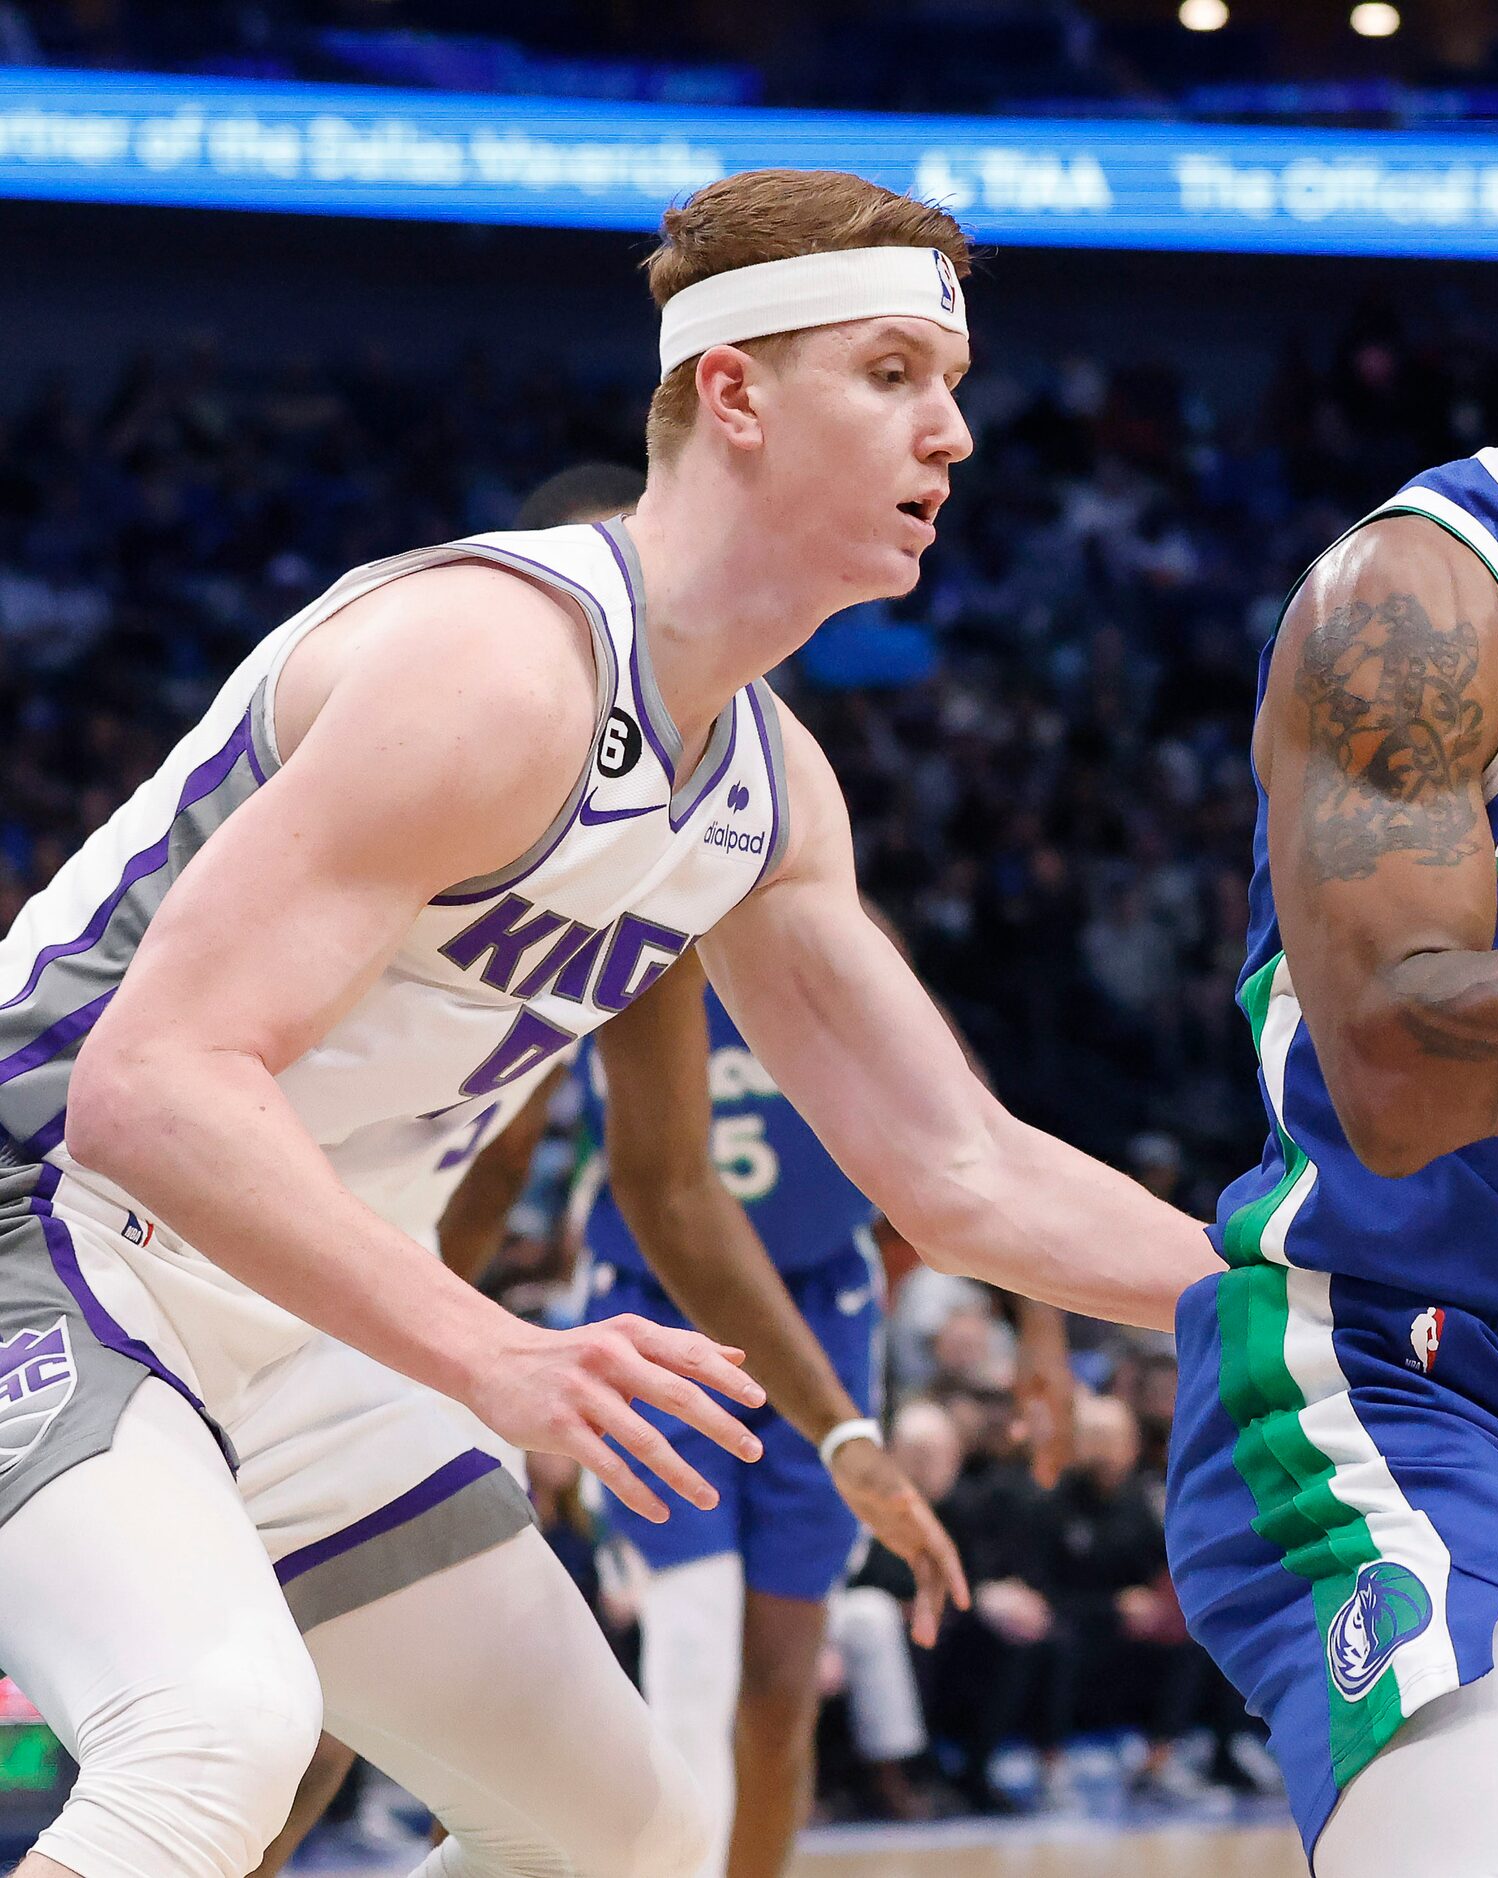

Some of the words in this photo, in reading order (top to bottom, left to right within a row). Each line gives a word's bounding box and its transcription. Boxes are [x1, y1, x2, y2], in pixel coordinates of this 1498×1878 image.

[207, 110, 301, 177] the
[307, 116, 467, 184] Dallas
[1173, 153, 1276, 217] The
[600, 716, 629, 771] 6
[703, 821, 766, 854] dialpad
[710, 1112, 781, 1201] 5
